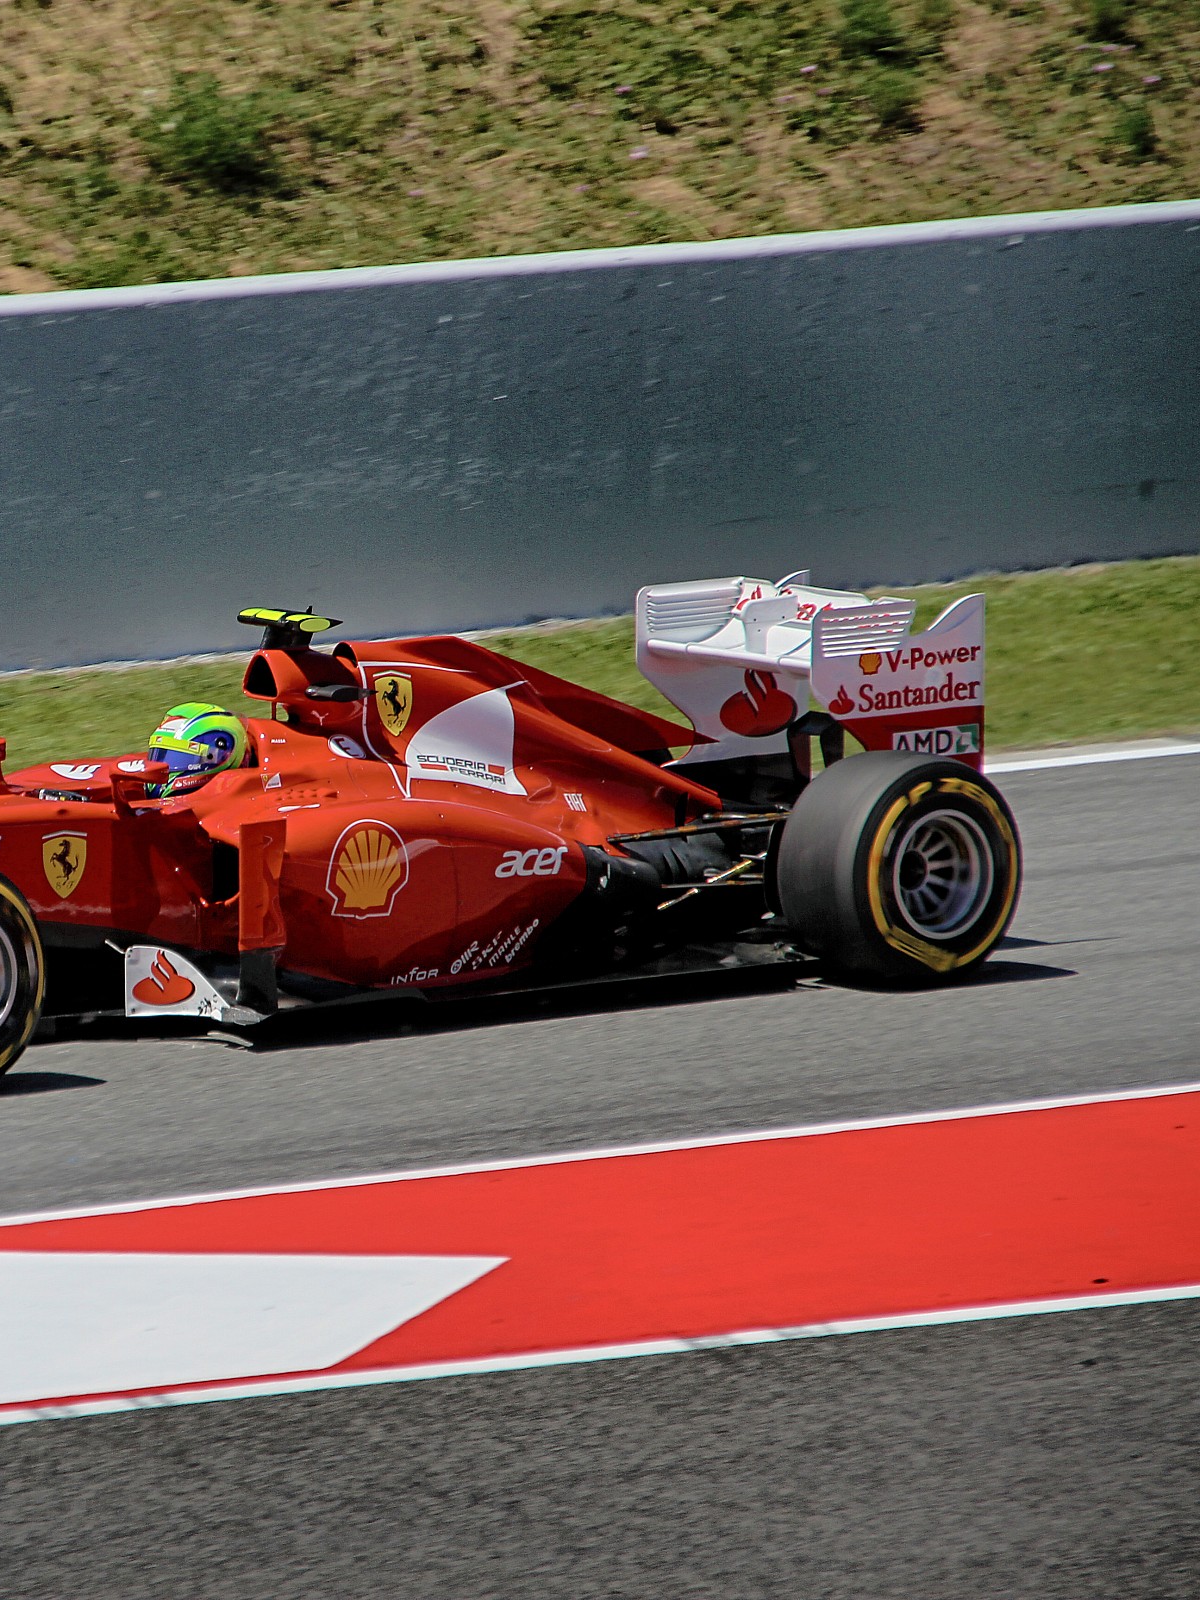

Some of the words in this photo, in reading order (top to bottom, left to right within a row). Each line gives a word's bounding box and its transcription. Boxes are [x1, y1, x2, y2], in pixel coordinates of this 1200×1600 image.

[886, 646, 981, 672] V-Power
[859, 672, 980, 712] Santander
[897, 730, 953, 754] AMD
[417, 755, 486, 772] SCUDERIA
[449, 767, 506, 785] FERRARI
[563, 793, 587, 812] FIAT
[494, 846, 568, 878] acer
[505, 919, 539, 963] brembo
